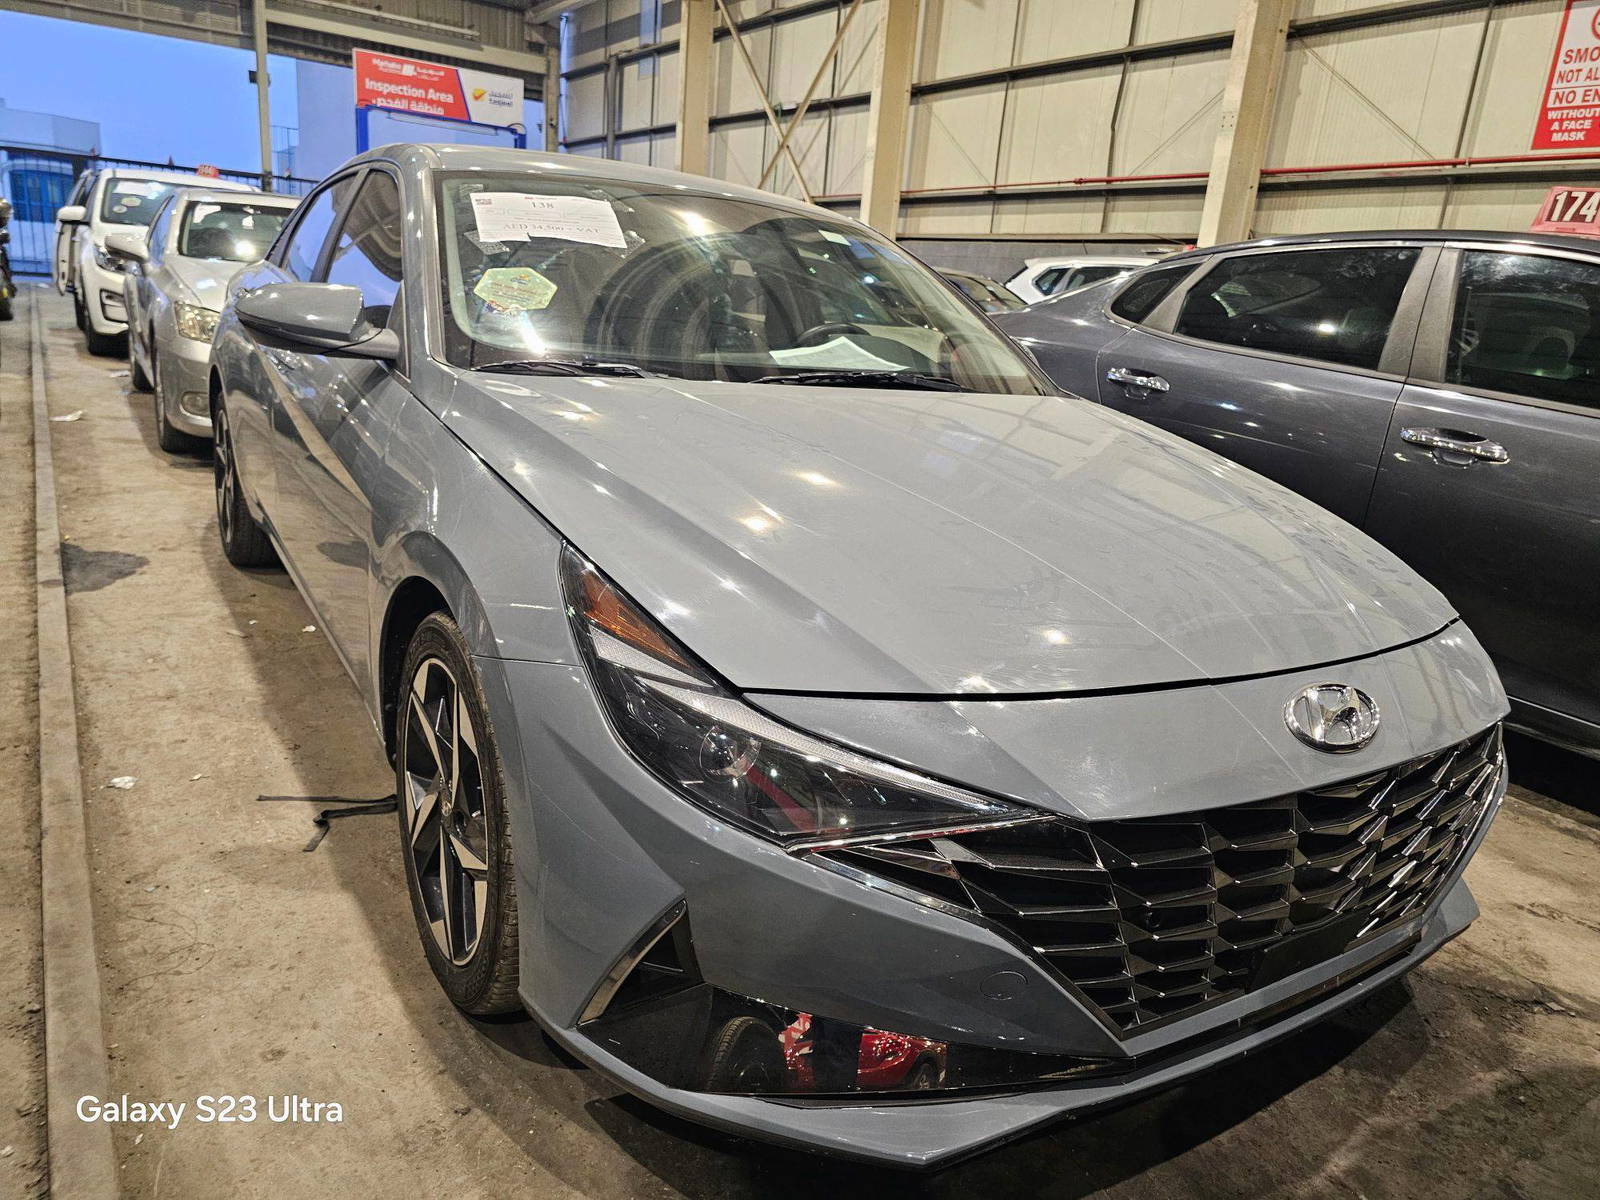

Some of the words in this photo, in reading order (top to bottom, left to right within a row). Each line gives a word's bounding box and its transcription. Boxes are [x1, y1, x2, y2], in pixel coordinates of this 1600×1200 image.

[1557, 69, 1583, 84] NOT
[365, 78, 426, 99] Inspection
[427, 88, 454, 104] Area
[1553, 90, 1577, 104] NO
[1547, 108, 1600, 119] WITHOUT
[1550, 121, 1560, 131] A
[1562, 119, 1593, 130] FACE
[1551, 131, 1586, 142] MASK
[1550, 191, 1600, 222] 174
